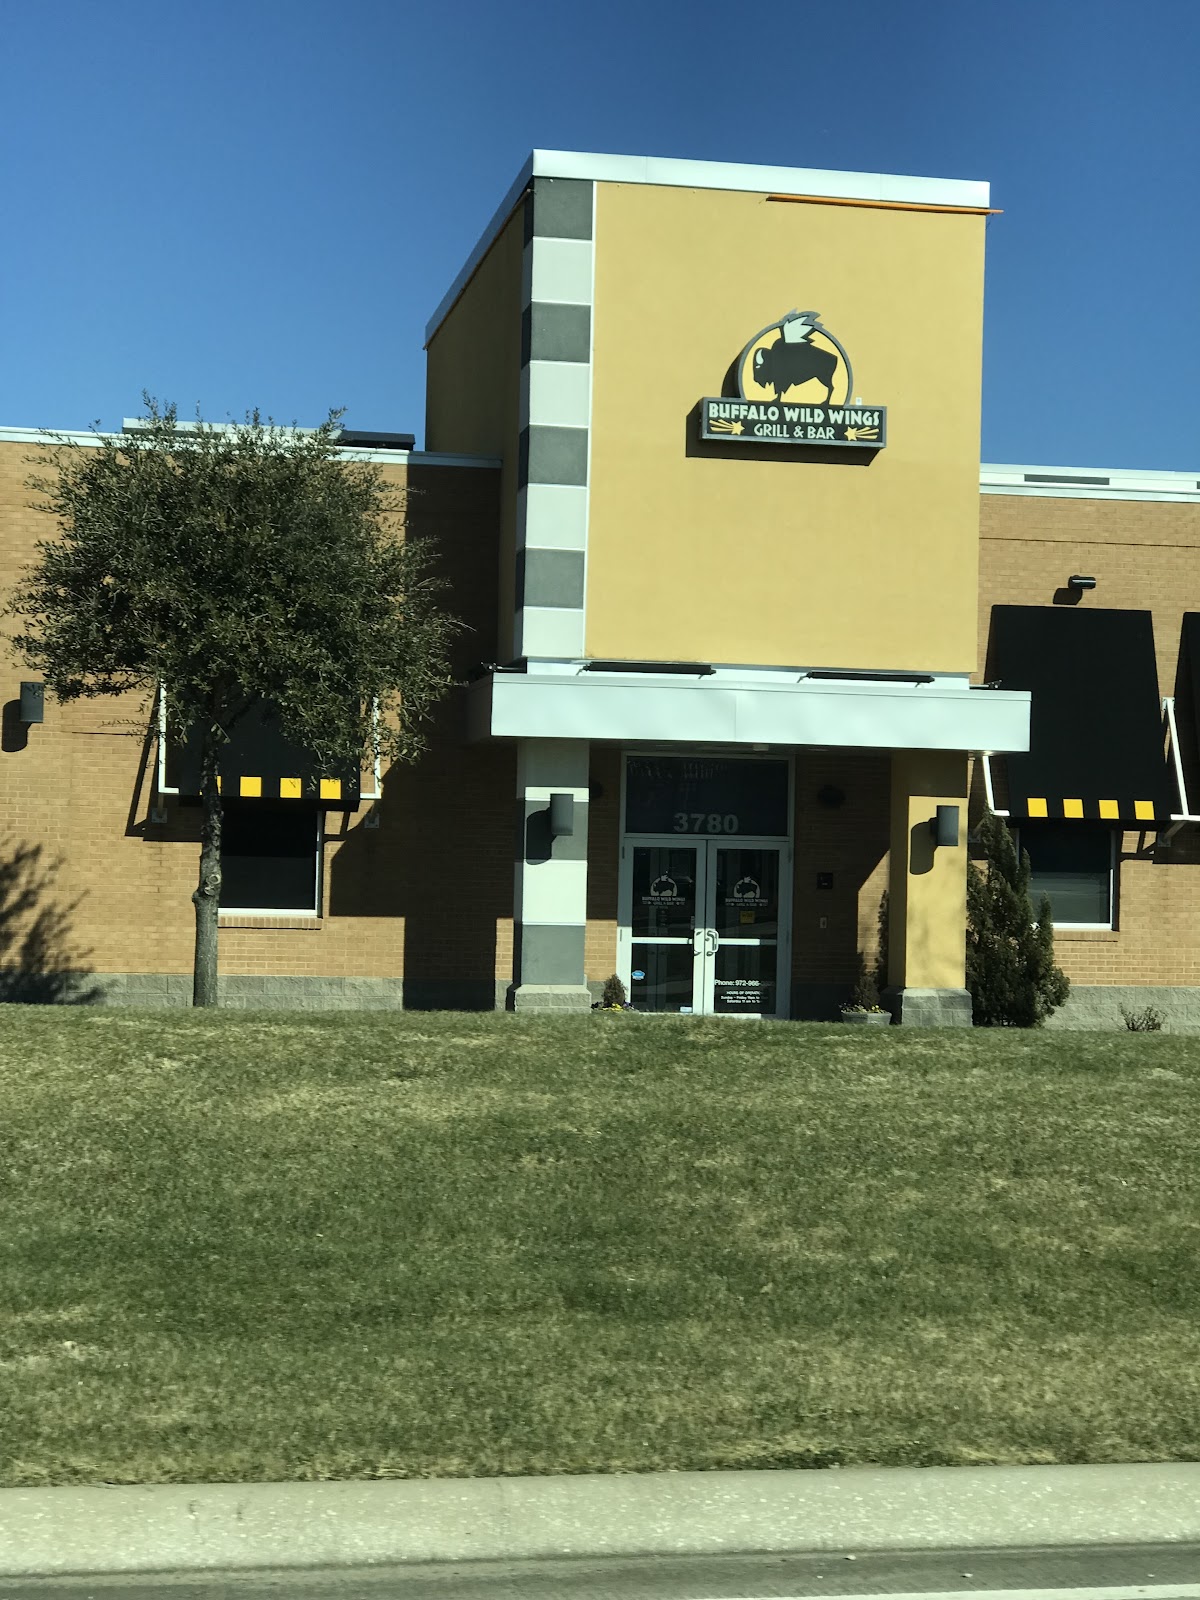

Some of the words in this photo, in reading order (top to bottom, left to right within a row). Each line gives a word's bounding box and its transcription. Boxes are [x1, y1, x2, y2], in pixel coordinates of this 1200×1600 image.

[709, 402, 780, 421] BUFFALO
[783, 406, 825, 423] WILD
[828, 408, 880, 426] WINGS
[753, 423, 790, 438] GRILL
[793, 425, 804, 438] &
[807, 425, 835, 440] BAR
[673, 812, 740, 833] 3780
